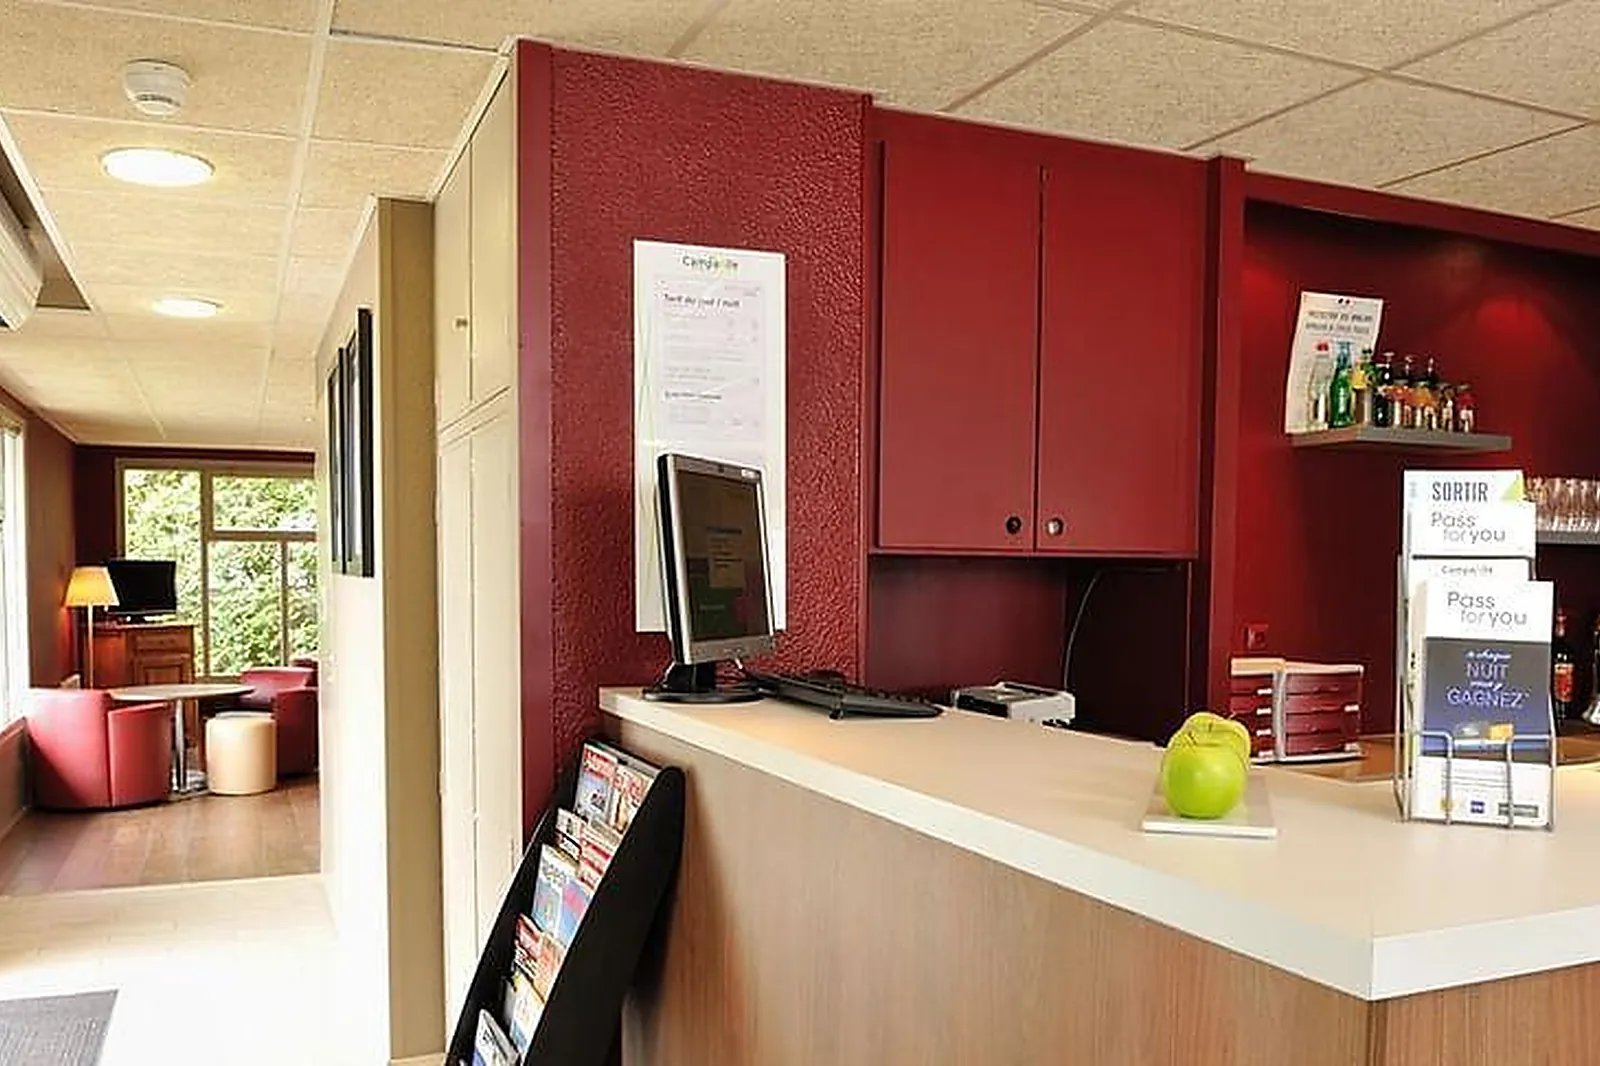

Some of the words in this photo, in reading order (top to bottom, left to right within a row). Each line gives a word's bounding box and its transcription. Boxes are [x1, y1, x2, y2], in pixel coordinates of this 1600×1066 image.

[1432, 481, 1489, 502] SORTIR
[1431, 511, 1477, 528] Pass
[1447, 591, 1495, 609] Pass
[1466, 663, 1510, 679] NUIT
